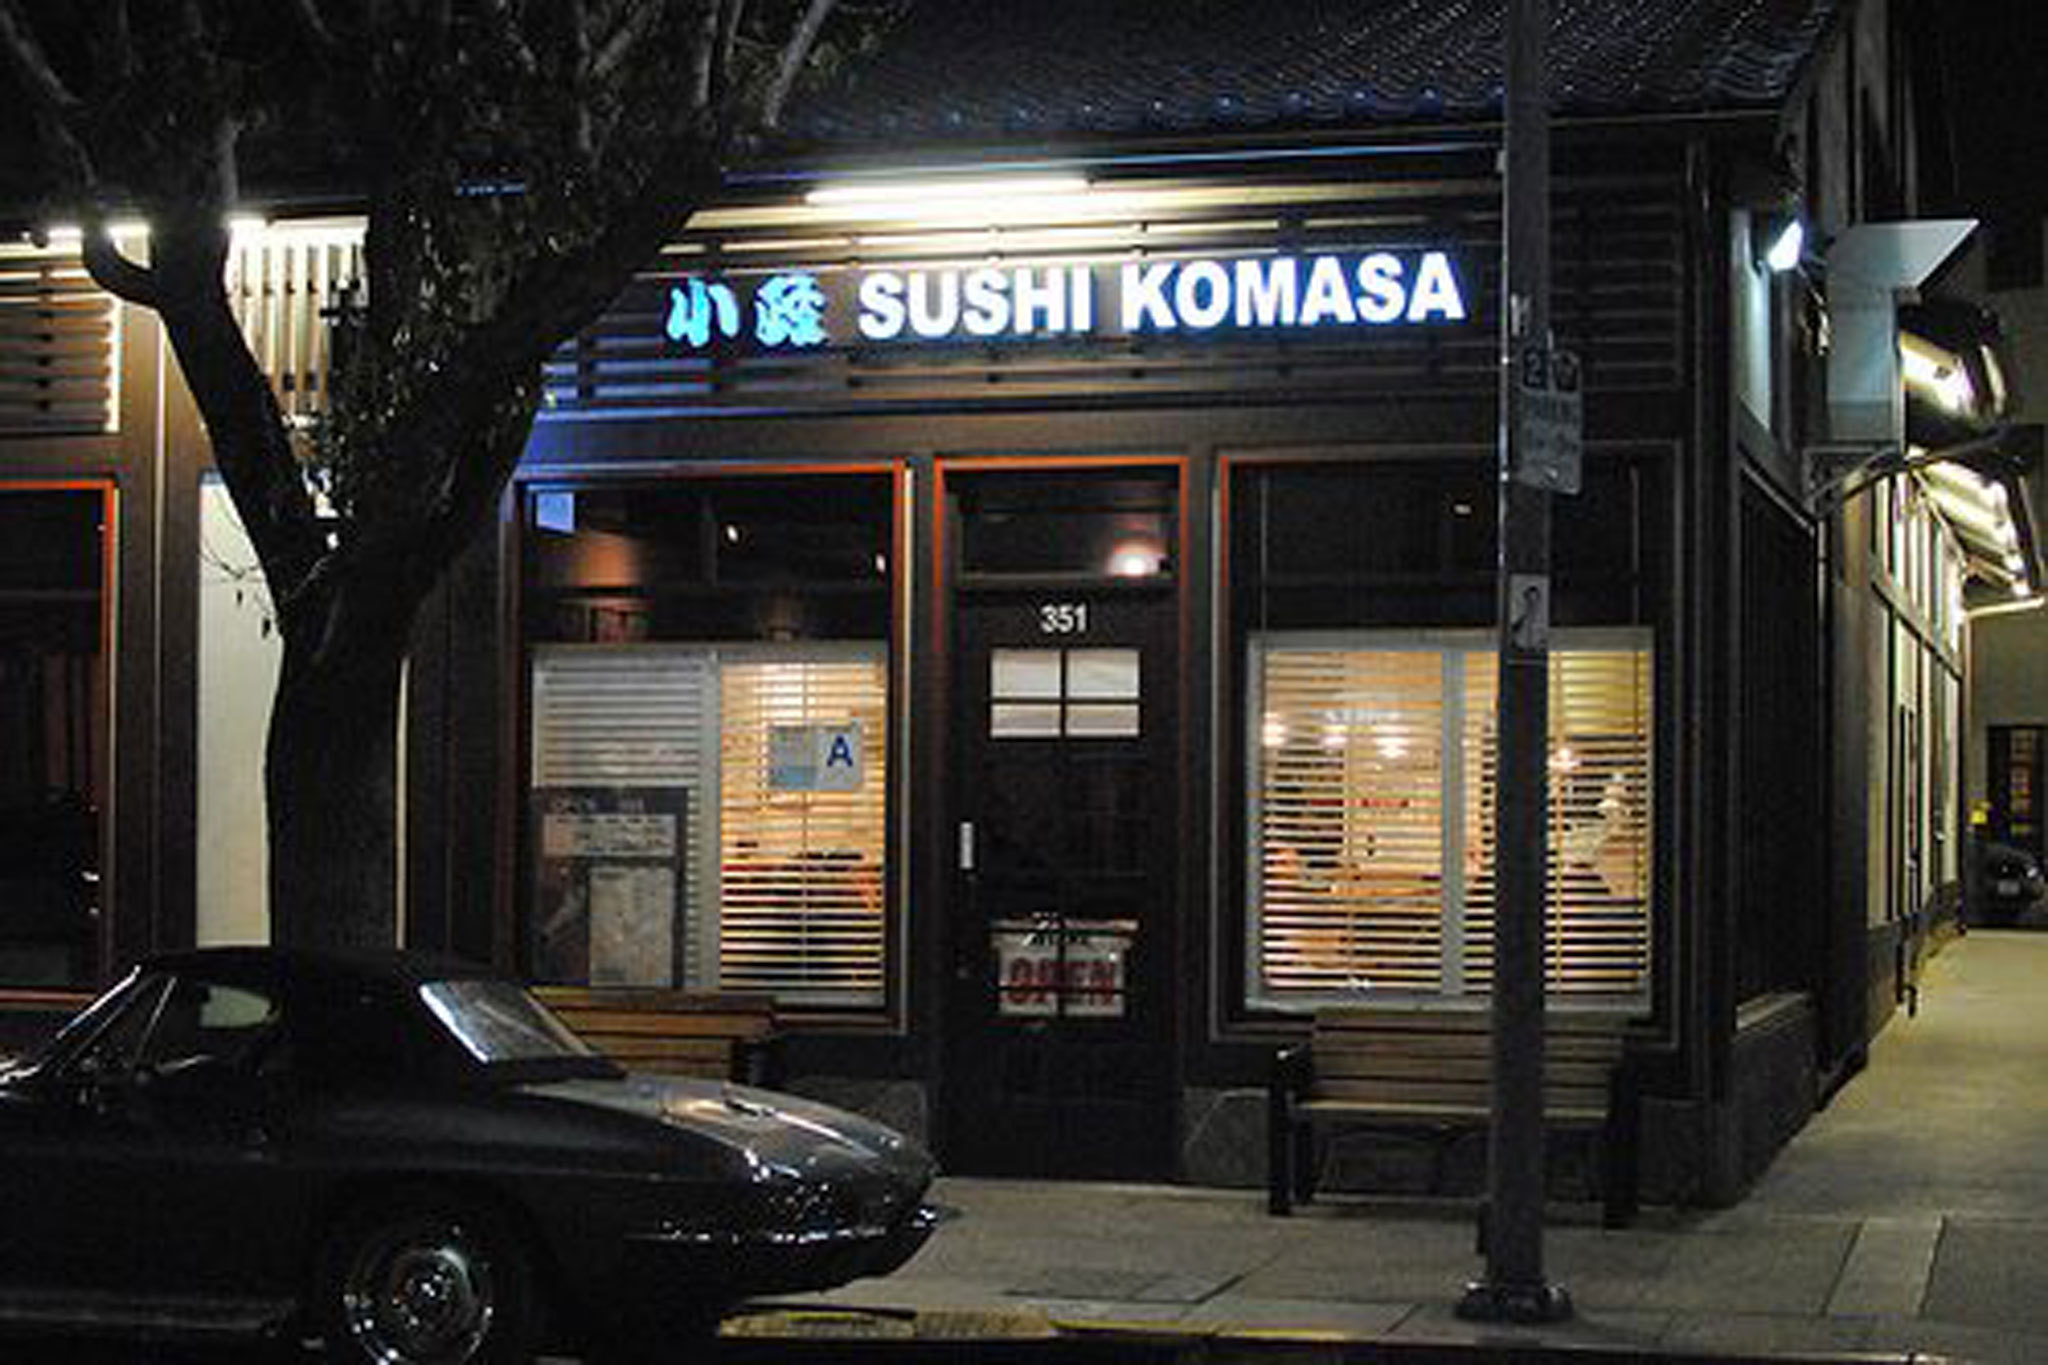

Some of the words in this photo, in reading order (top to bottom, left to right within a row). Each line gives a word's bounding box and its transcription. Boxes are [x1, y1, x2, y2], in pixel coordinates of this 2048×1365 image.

[858, 265, 1091, 340] SUSHI
[1121, 252, 1465, 329] KOMASA
[1040, 604, 1088, 633] 351
[826, 734, 853, 767] A
